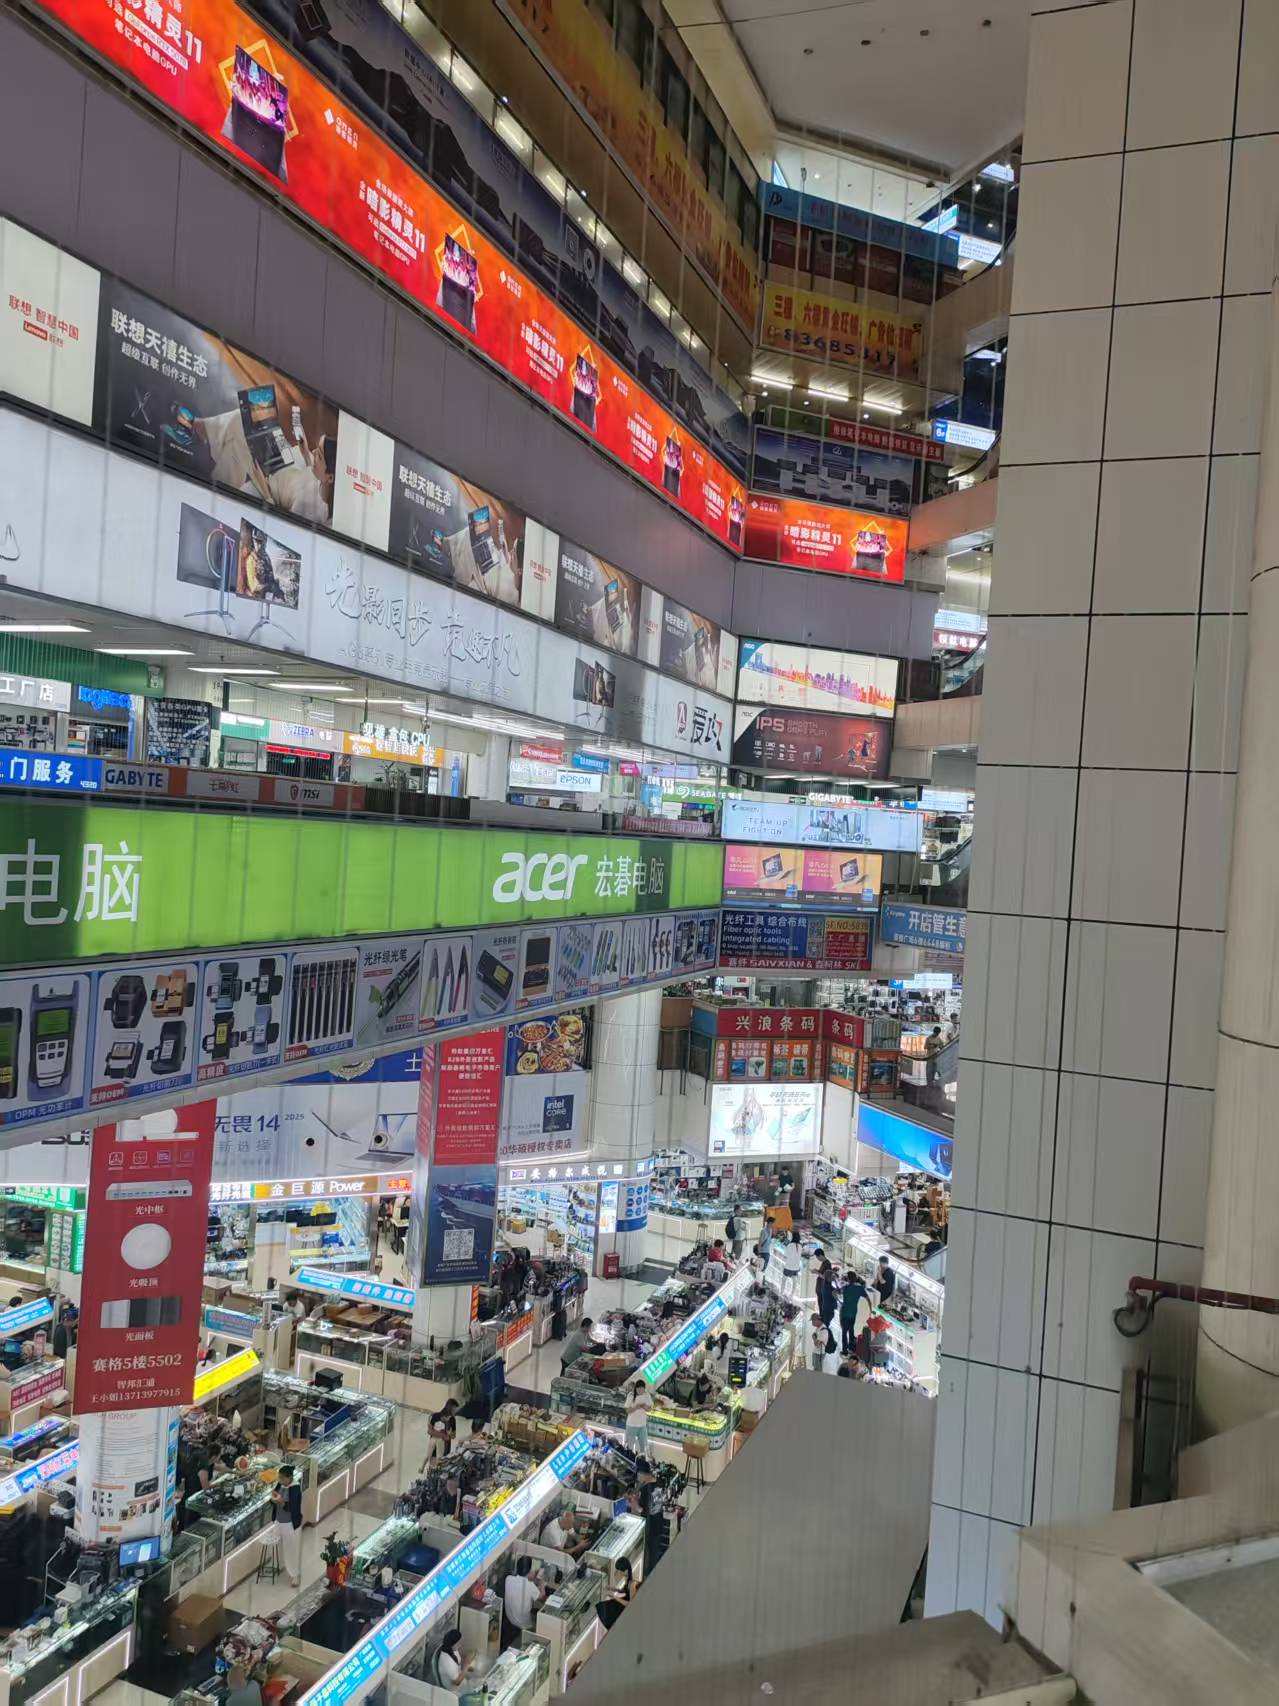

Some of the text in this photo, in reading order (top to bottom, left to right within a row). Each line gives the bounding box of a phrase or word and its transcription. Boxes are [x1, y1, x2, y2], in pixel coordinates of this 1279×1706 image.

[367, 186, 425, 253] 暗影精灵11
[9, 295, 79, 341] 联想 智慧中国
[110, 308, 208, 378] 联想天禧生态
[690, 705, 723, 752] 爱攻
[756, 716, 785, 733] IPS
[560, 776, 592, 785] EPSON
[0, 838, 143, 926] 电脑
[492, 851, 664, 903] acer 宏碁电脑
[724, 914, 764, 926] 光纤工具
[735, 1015, 816, 1032] 兴浪条码
[831, 1018, 855, 1041] 条码
[285, 1113, 305, 1121] 2025
[271, 1180, 366, 1197] 金巨源 Power
[92, 1353, 183, 1373] 赛格5楼5502
